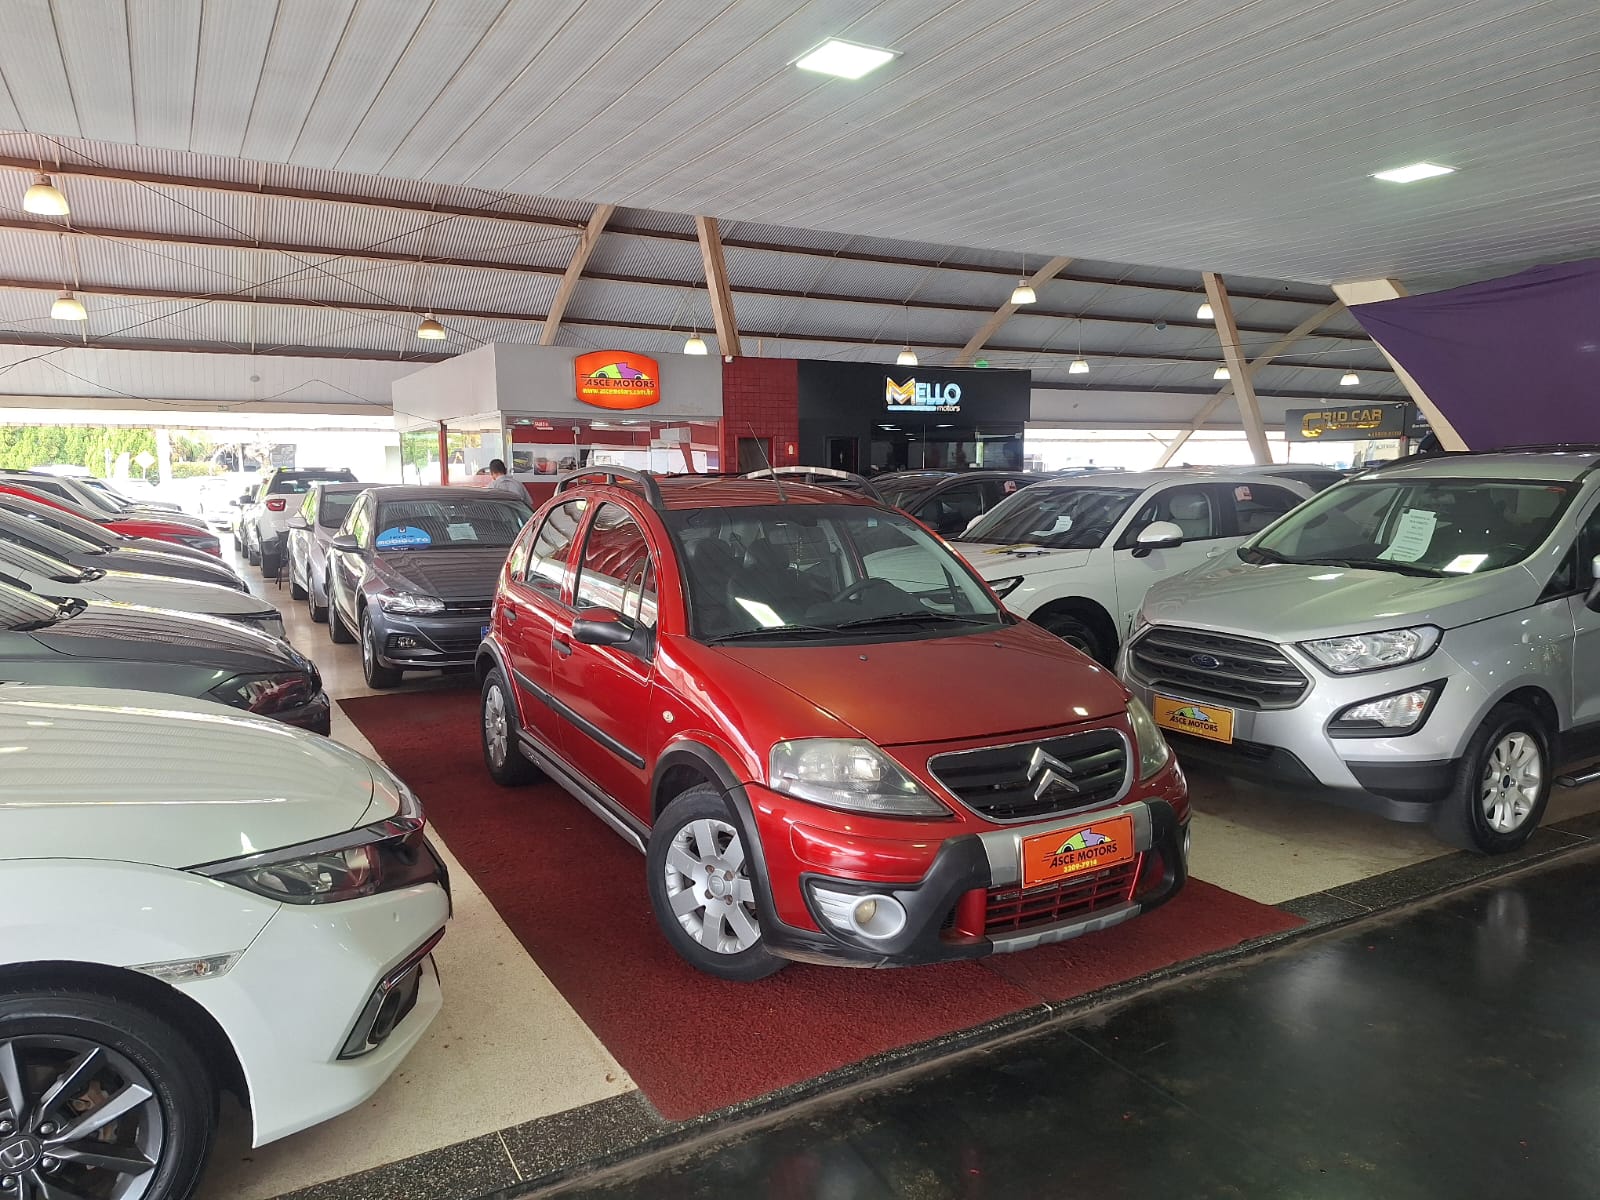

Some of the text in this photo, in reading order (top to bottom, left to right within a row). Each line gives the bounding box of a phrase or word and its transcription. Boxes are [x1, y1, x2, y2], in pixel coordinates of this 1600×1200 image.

[585, 379, 655, 388] ASCE MOTORS
[886, 377, 961, 405] MELLO
[1352, 409, 1382, 421] CAR
[1169, 716, 1187, 725] ASCE
[1188, 720, 1218, 732] MOTORS
[1050, 844, 1118, 868] ASCE MOTORS
